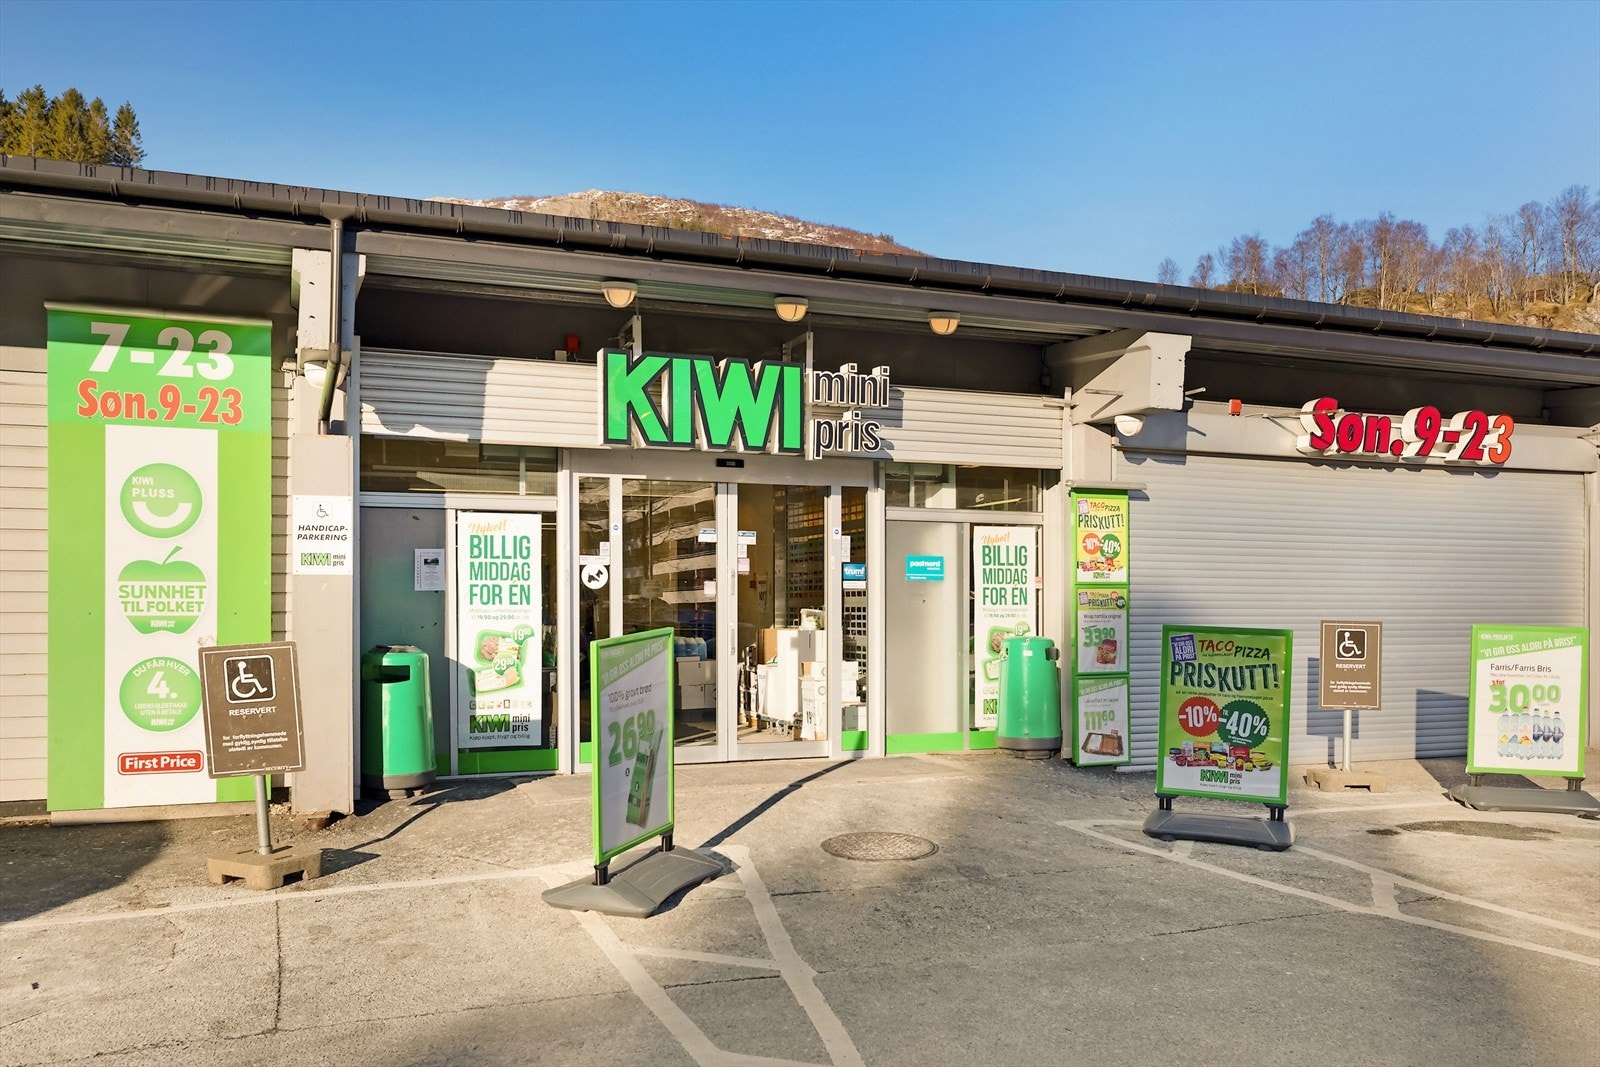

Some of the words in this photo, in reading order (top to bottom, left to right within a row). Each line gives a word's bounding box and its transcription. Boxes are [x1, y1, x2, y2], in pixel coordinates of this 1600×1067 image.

[89, 322, 234, 381] 7-23
[812, 362, 891, 409] mini
[603, 348, 806, 456] KIWI
[812, 410, 884, 465] pris
[132, 476, 154, 486] KIWI
[132, 487, 175, 499] PLUSS
[298, 524, 349, 532] HANDICAP-
[1078, 513, 1125, 531] PRISKUTT!
[297, 533, 348, 541] PARKERING
[469, 534, 531, 560] BILLIG
[982, 545, 1028, 567] BILLIG
[301, 552, 332, 566] KIWI
[910, 560, 941, 568] postnord
[469, 561, 531, 581] MIDDAG
[982, 568, 1028, 585] MIDDAG
[118, 584, 207, 600] SUNNHET
[469, 584, 503, 606] FOR
[509, 579, 531, 606] ÉN
[983, 588, 1008, 606] FOR
[1011, 584, 1028, 606] ÉN
[121, 601, 144, 613] TIL
[147, 601, 205, 613] FOLKET
[1174, 646, 1194, 655] ALDRI
[1198, 640, 1235, 653] TACO
[1234, 645, 1270, 661] PIZZA
[1492, 646, 1505, 656] GIR
[1505, 644, 1521, 655] OSS
[1521, 640, 1543, 653] ALDRI
[1543, 637, 1554, 649] PÅ
[133, 665, 147, 677] DU
[147, 659, 165, 670] FÅR
[166, 660, 191, 677] HVER
[1170, 661, 1280, 692] PRISKUTT!
[1490, 663, 1536, 673] Farris/Farris
[1537, 665, 1552, 673] Bris
[147, 671, 178, 699] 4.
[608, 690, 625, 704] 100%
[1488, 684, 1561, 714] 3000
[229, 706, 276, 717] RESERVERT
[512, 714, 530, 723] mini
[1178, 706, 1217, 728] -10%
[470, 714, 510, 733] KIWI
[512, 723, 529, 734] pris
[1217, 711, 1267, 738] -40%
[125, 758, 159, 770] First
[160, 755, 197, 768] Price
[1200, 769, 1228, 784] KIWI
